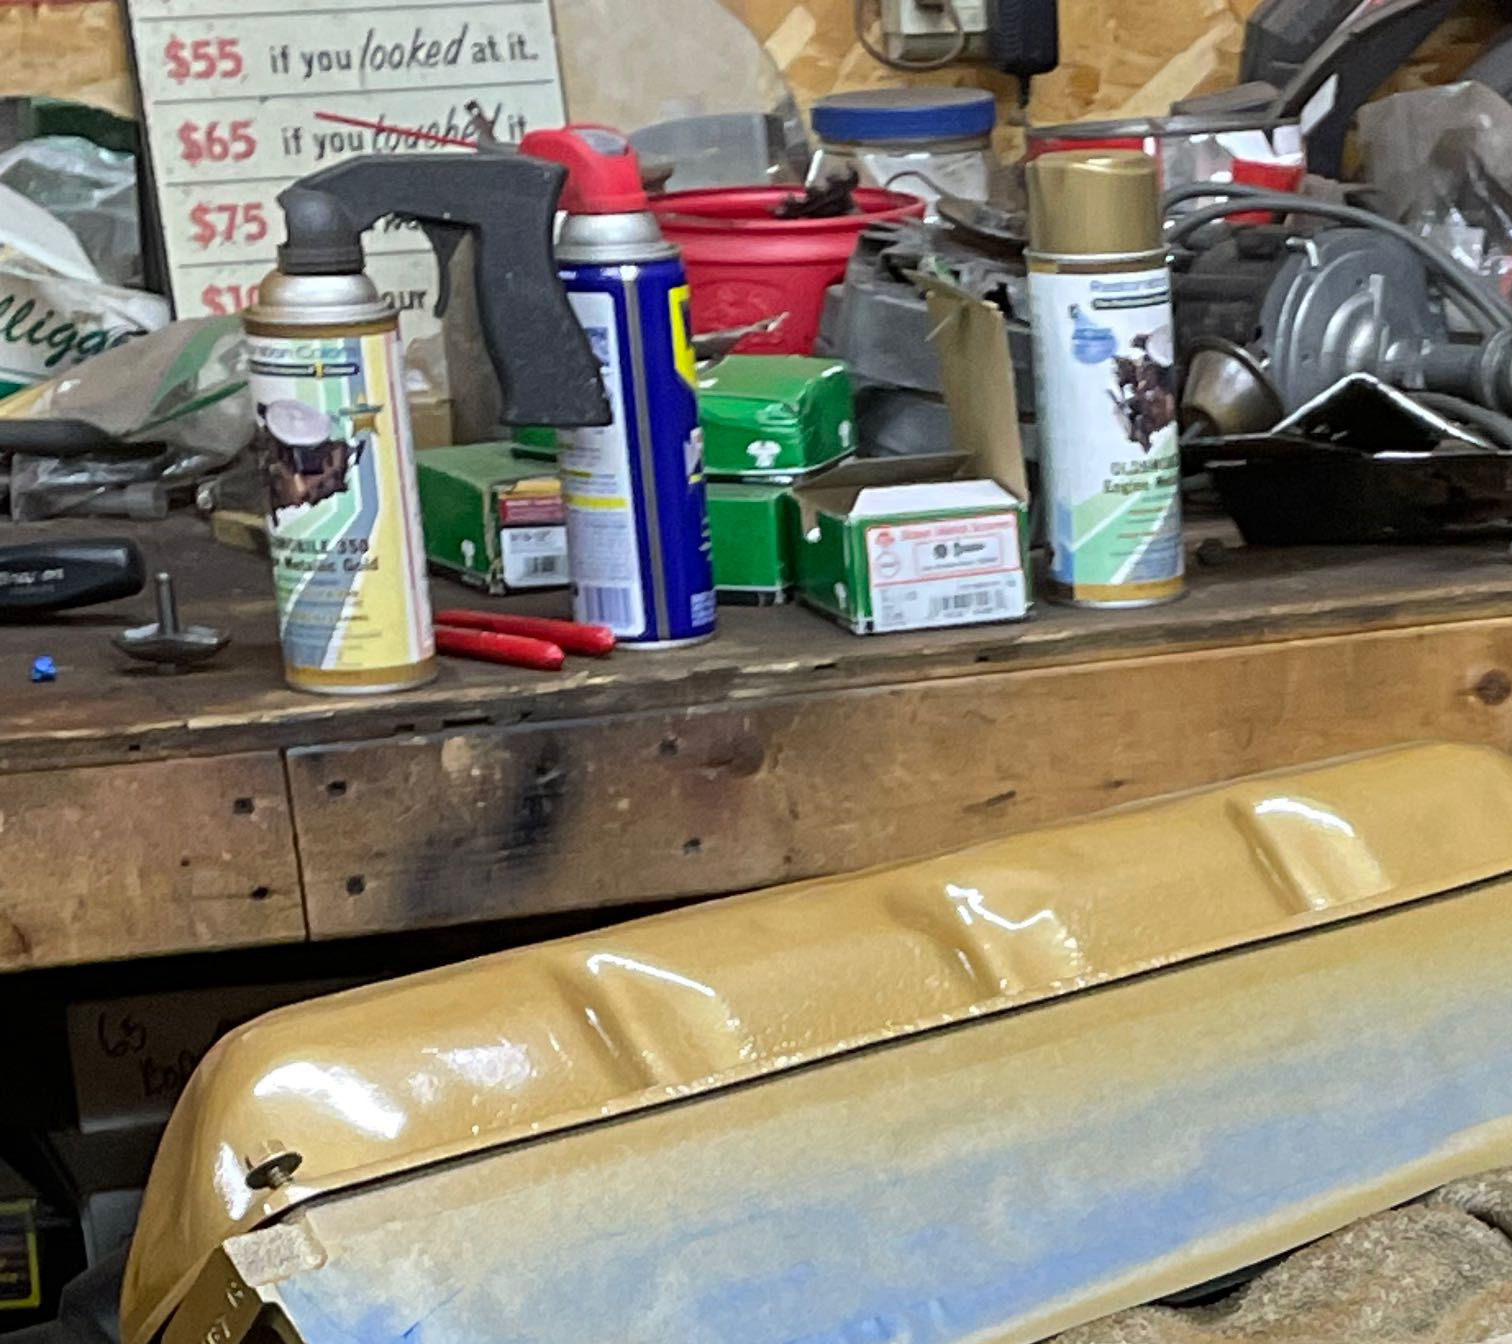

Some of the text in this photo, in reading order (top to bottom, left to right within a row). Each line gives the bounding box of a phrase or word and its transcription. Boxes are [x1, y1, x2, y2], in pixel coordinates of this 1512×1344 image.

[164, 33, 244, 85] $55
[270, 46, 290, 75] if
[302, 50, 351, 79] you
[360, 23, 469, 74] looked
[471, 37, 503, 65] at
[177, 118, 258, 167] $65
[281, 127, 301, 157] if
[313, 130, 365, 163] you
[190, 202, 268, 251] $75
